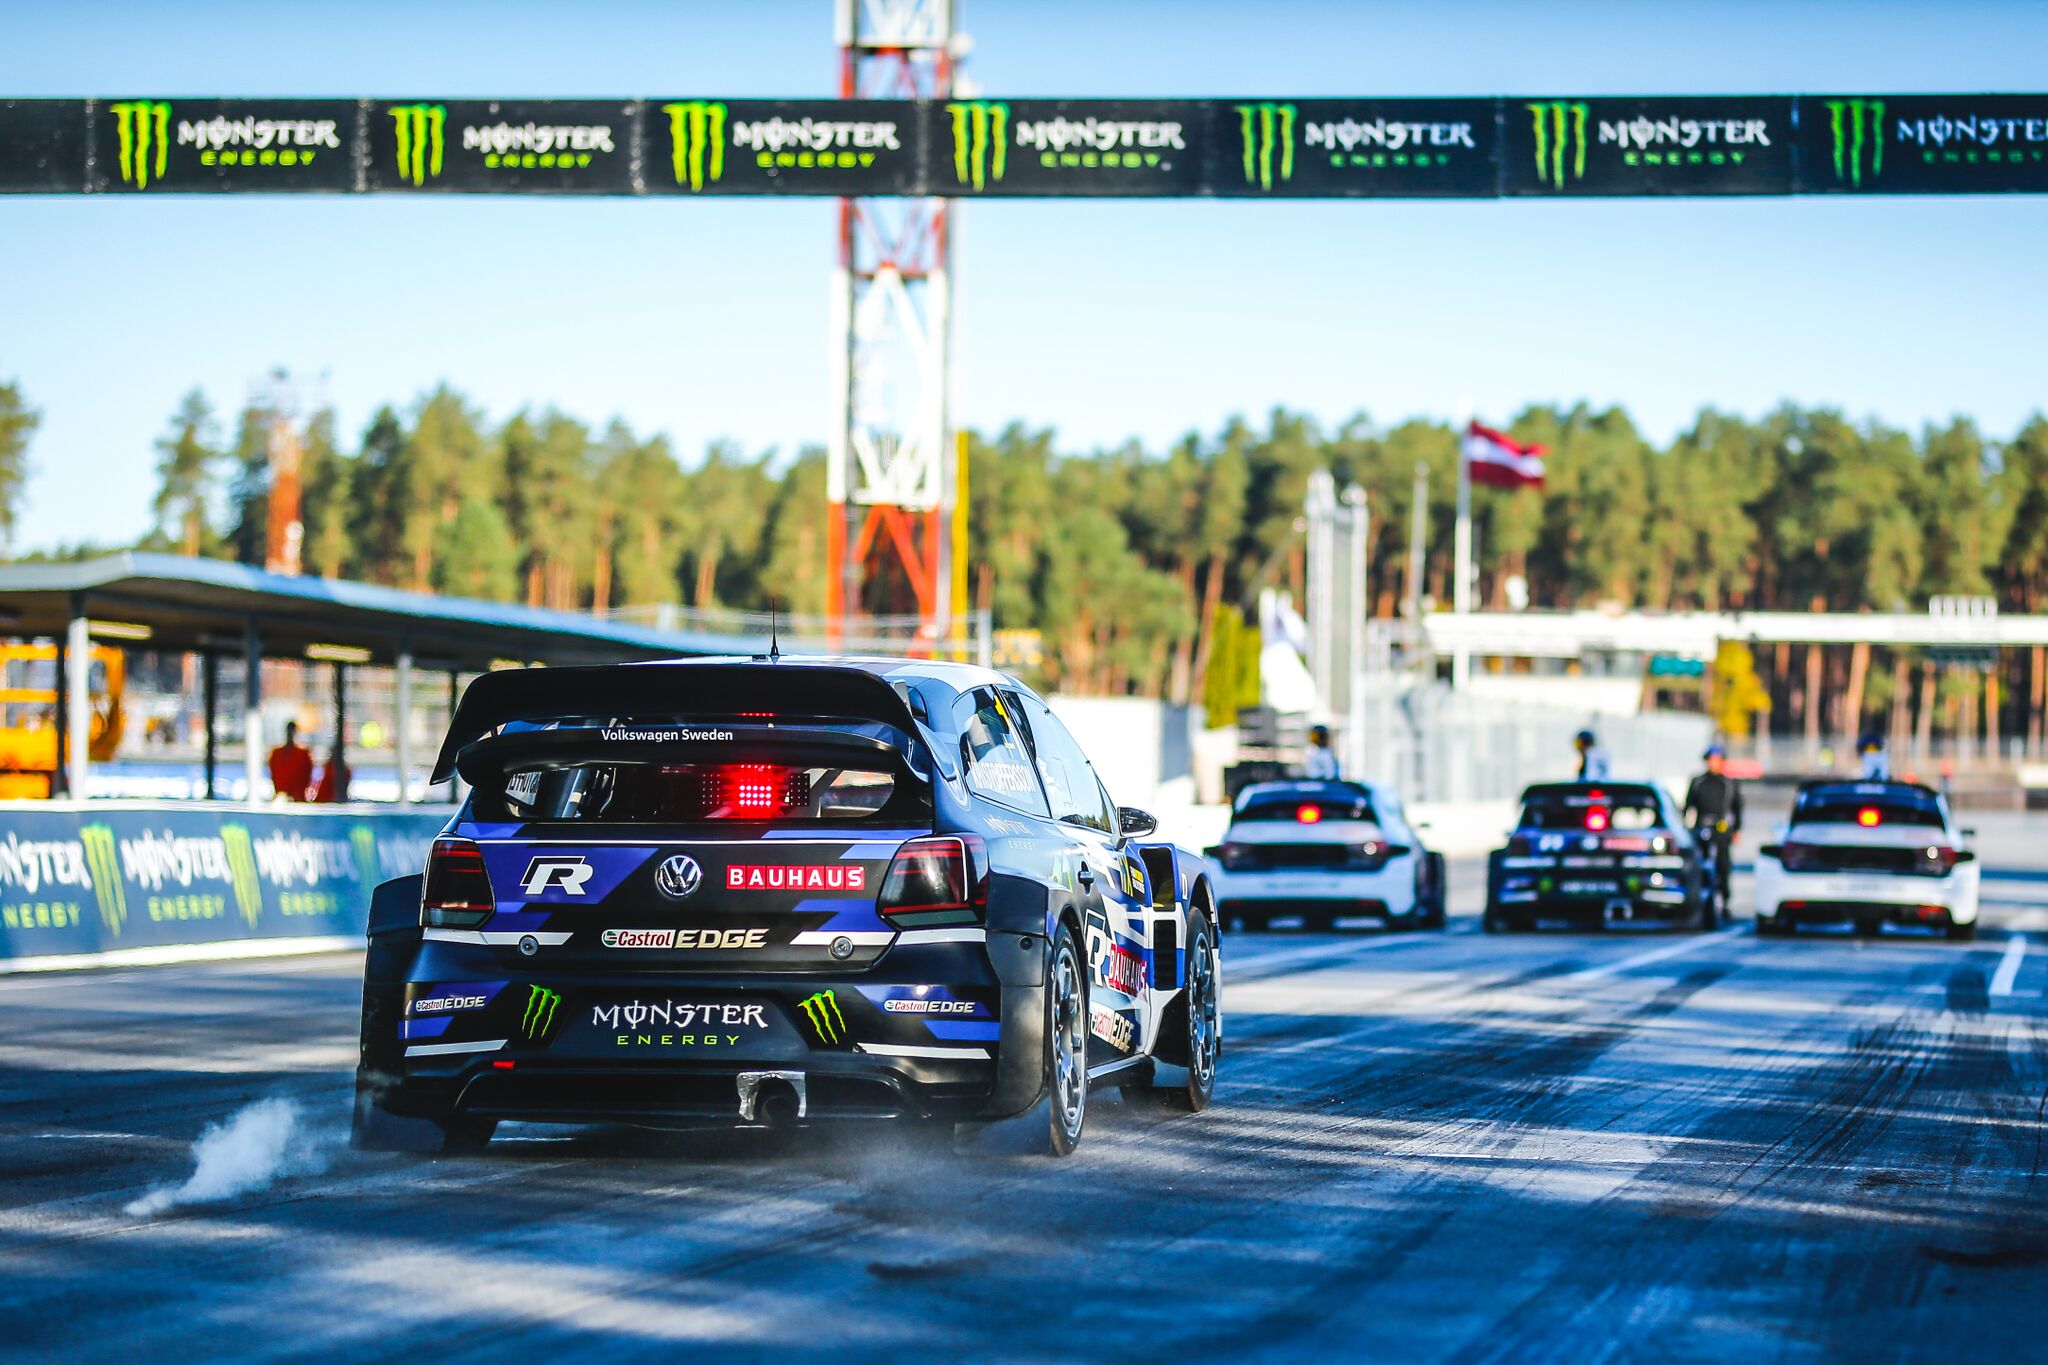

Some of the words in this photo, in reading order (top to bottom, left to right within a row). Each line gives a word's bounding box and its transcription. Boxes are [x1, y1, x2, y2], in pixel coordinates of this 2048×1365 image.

[177, 115, 341, 150] MONSTER
[462, 121, 615, 153] MONSTER
[732, 116, 901, 152] MONSTER
[1015, 115, 1186, 152] MONSTER
[1304, 117, 1476, 152] MONSTER
[1598, 114, 1772, 150] MONSTER
[1896, 113, 2048, 148] MONSTE
[200, 150, 316, 166] ENERGY
[484, 152, 592, 168] ENERGY
[755, 151, 876, 168] ENERGY
[1039, 151, 1161, 168] ENERGY
[601, 728, 679, 743] Volkswagen
[681, 728, 734, 741] Sweden
[0, 830, 92, 894] NSTER
[119, 827, 233, 892] MONSTER
[519, 855, 594, 895] R
[729, 867, 863, 888] BAUHAUS
[2, 901, 80, 929] NERGY
[148, 893, 226, 921] ENERGY
[617, 930, 672, 947] Castrol
[674, 928, 770, 949] EDGE
[1108, 950, 1148, 993] BAUHAUS
[420, 1000, 443, 1010] Castrol
[443, 995, 486, 1010] EDGE
[592, 1000, 768, 1030] MONSTER
[894, 1001, 927, 1012] Castrol
[926, 1000, 975, 1014] EDGE
[616, 1034, 737, 1046] ENERGY
[1110, 1011, 1135, 1054] EDGE
